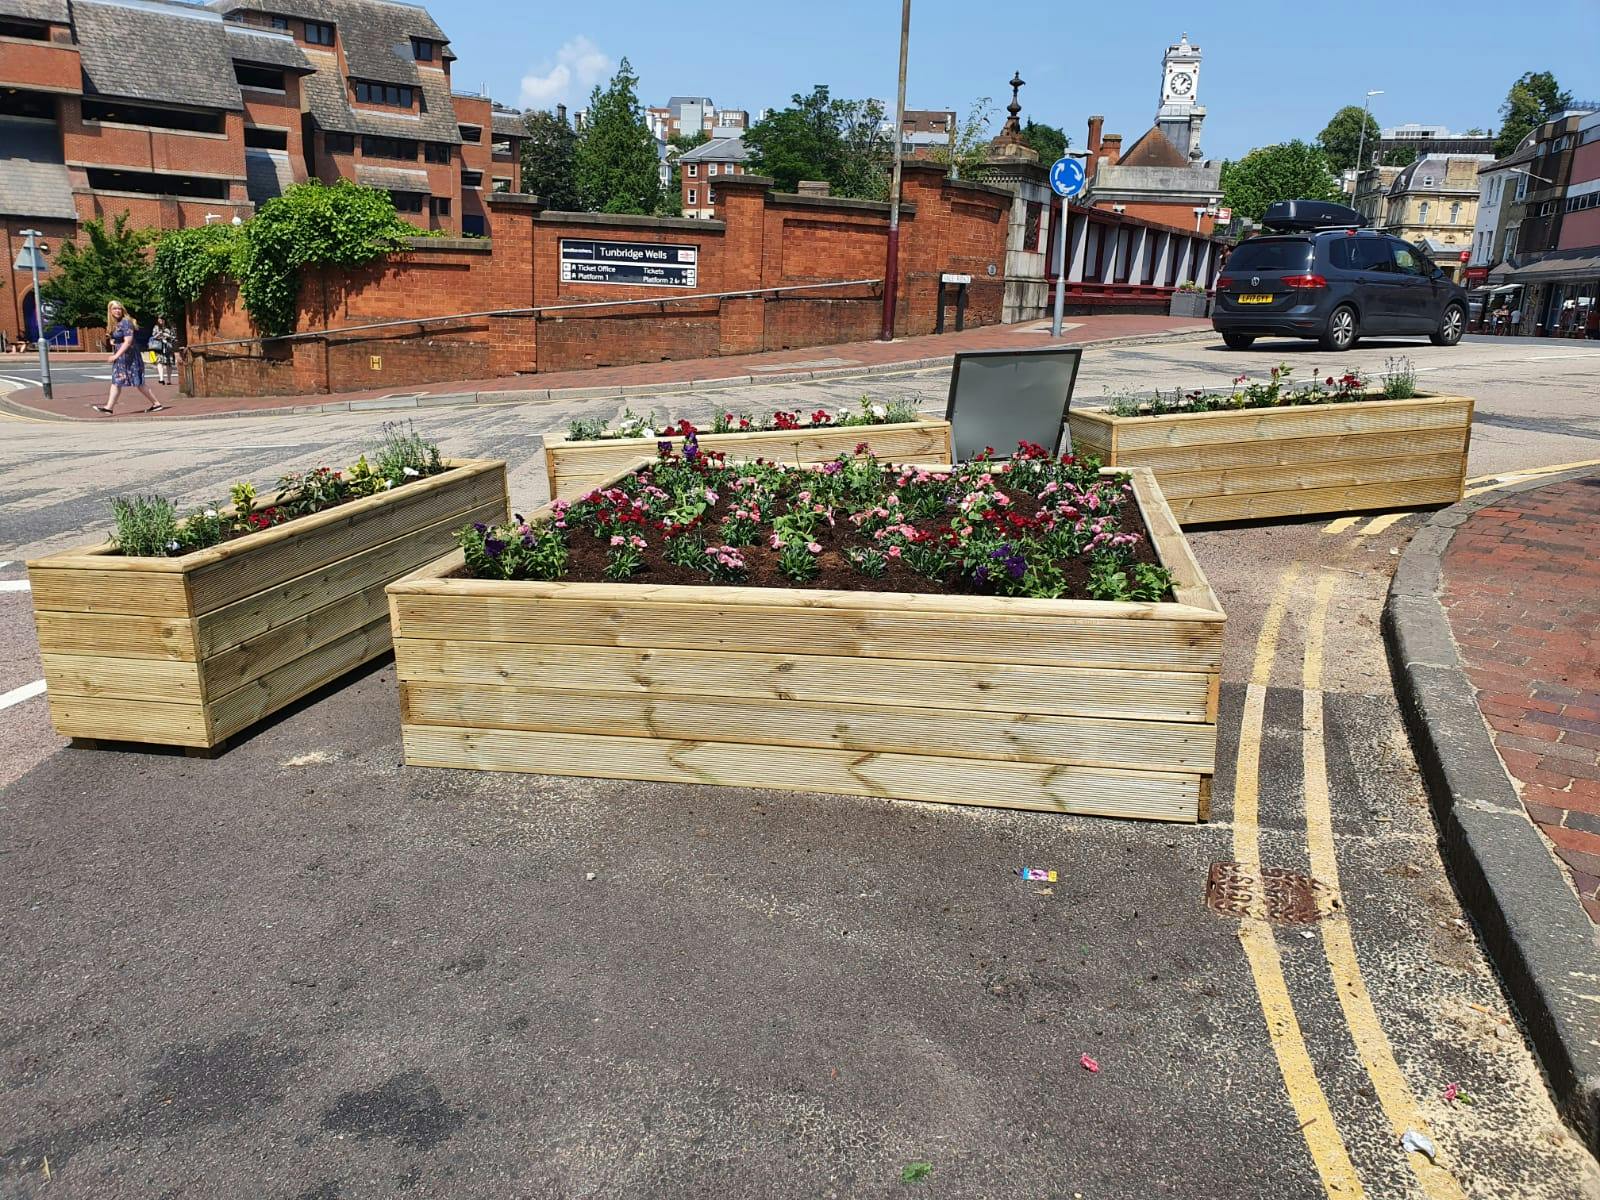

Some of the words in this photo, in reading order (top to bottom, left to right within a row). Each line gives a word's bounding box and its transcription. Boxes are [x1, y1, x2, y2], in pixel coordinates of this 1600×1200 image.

[600, 247, 643, 260] Tunbridge
[645, 249, 667, 259] Wells
[578, 264, 596, 272] Ticket
[643, 267, 664, 275] Tickets
[642, 276, 668, 284] Platform
